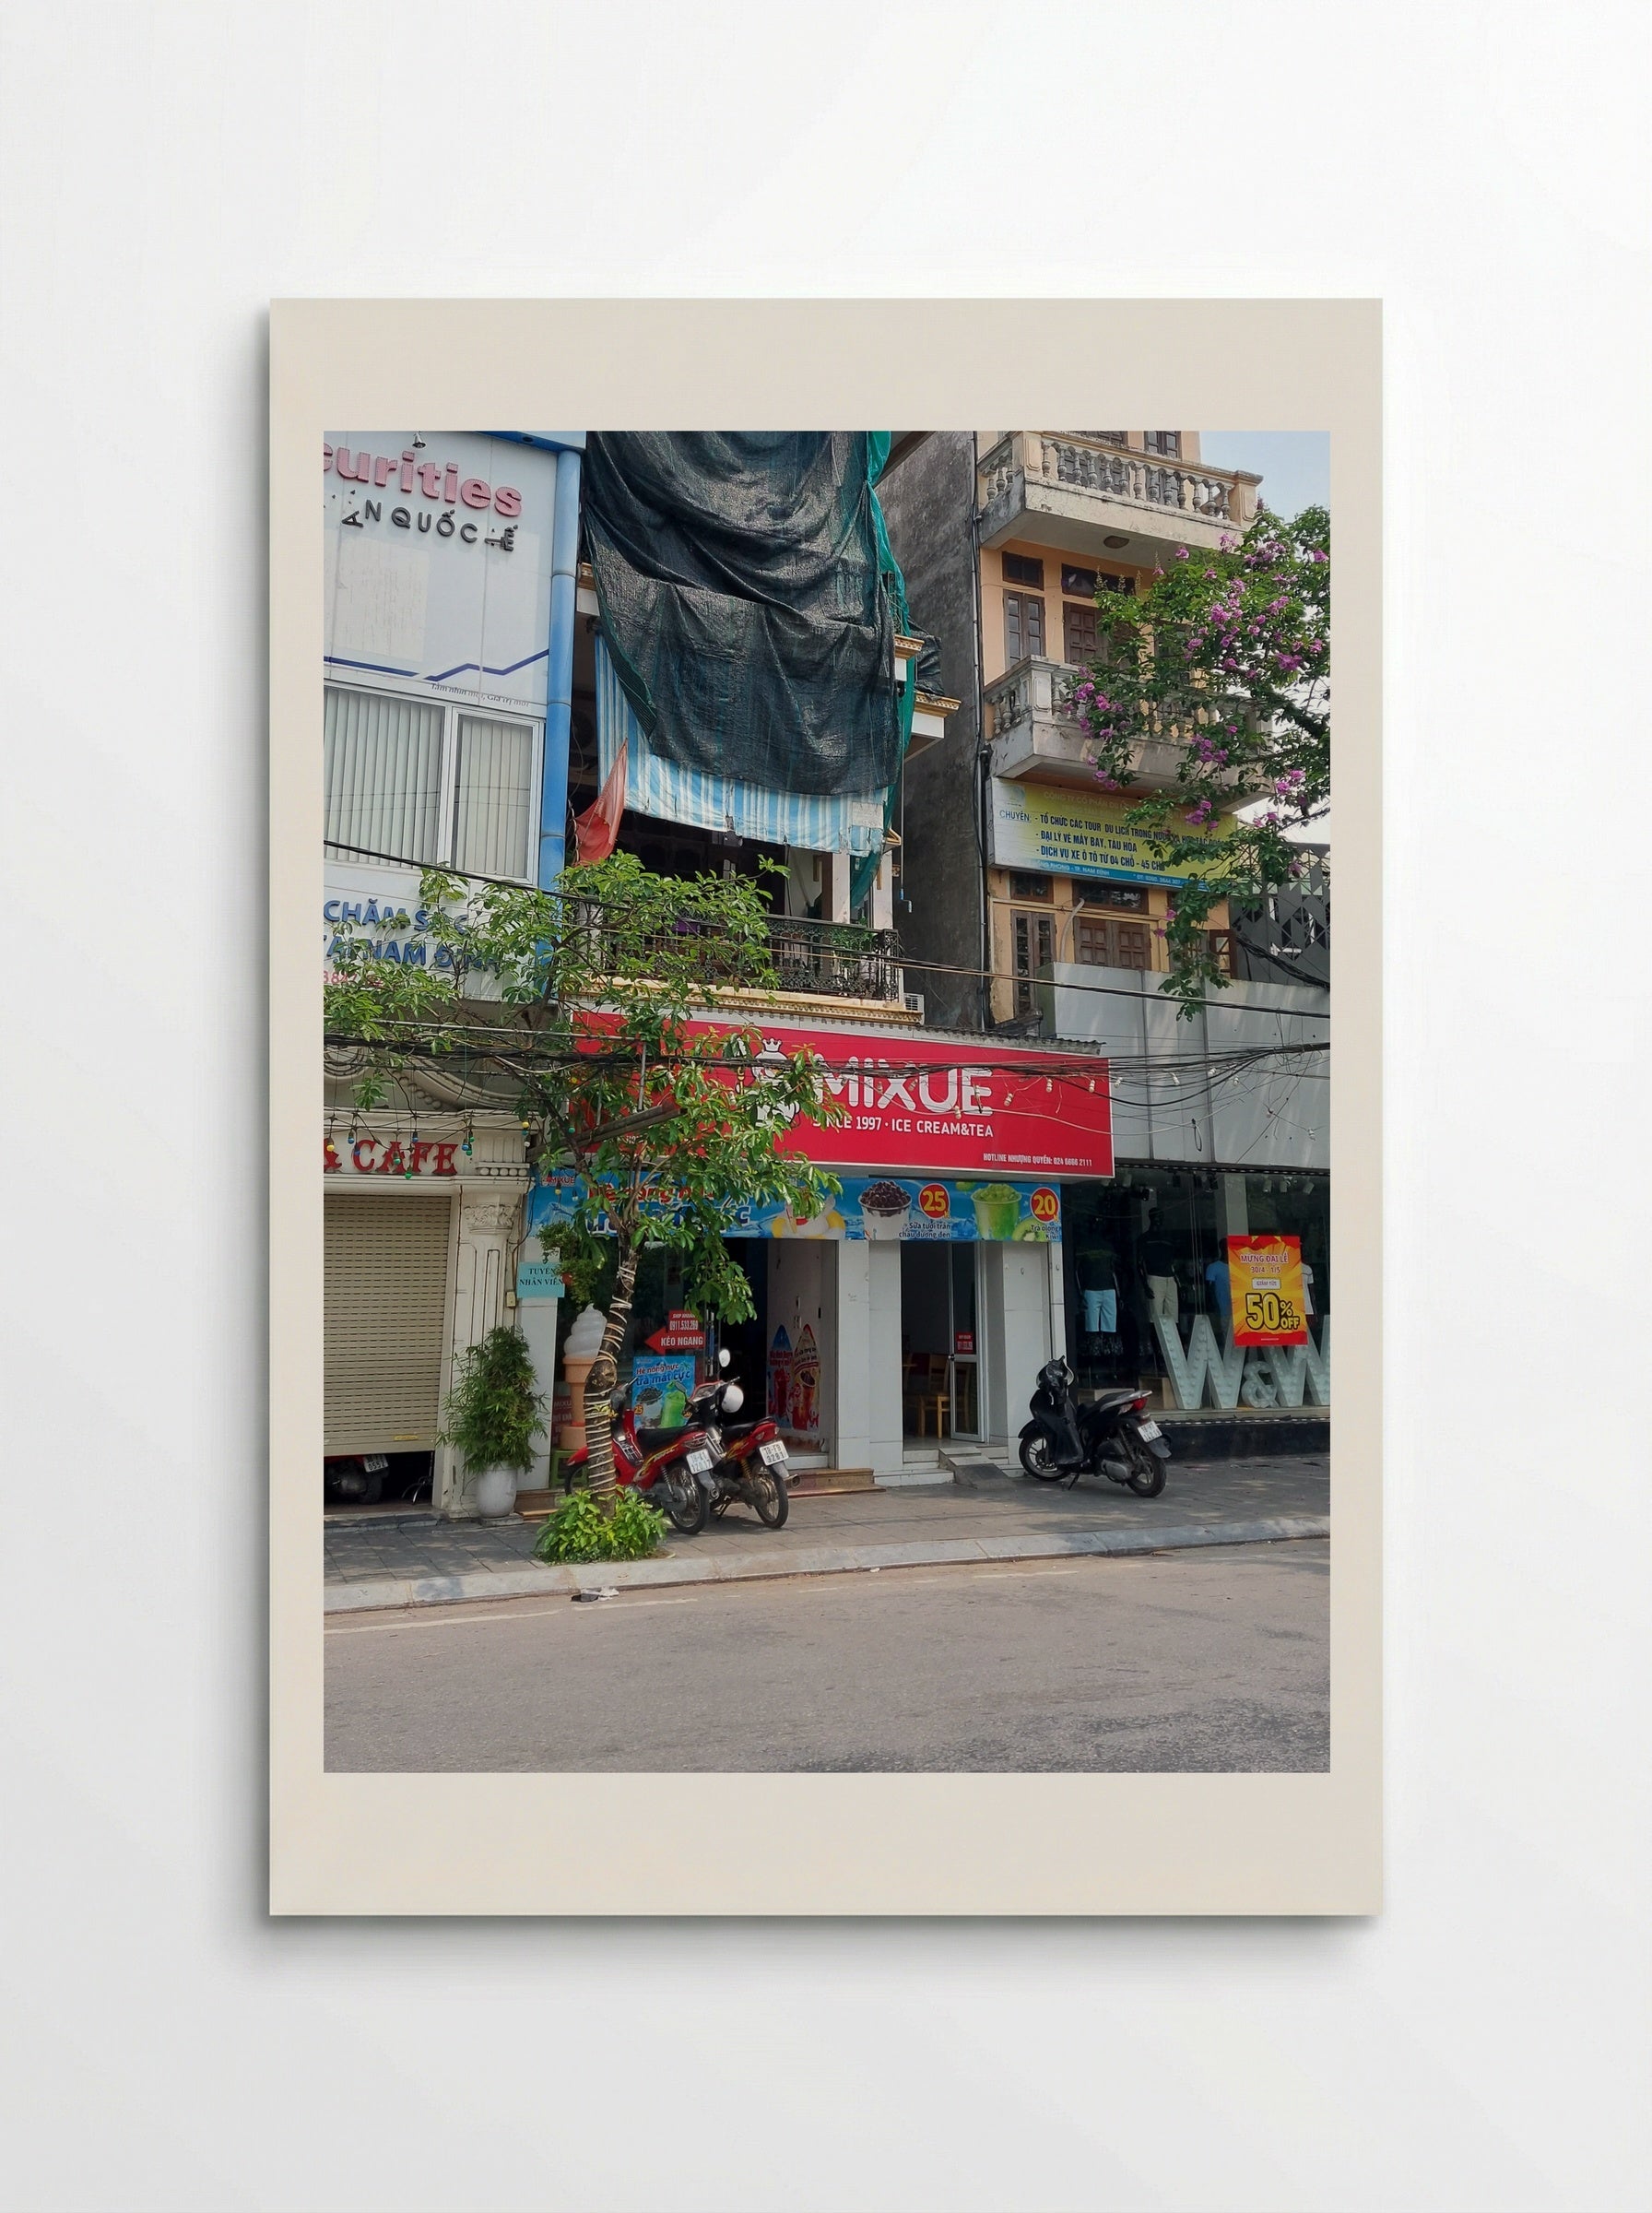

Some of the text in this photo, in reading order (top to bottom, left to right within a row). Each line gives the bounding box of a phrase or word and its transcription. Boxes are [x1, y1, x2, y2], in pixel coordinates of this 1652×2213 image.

[1040, 811, 1048, 823] TỔ
[1051, 815, 1068, 826] CHỨC
[1069, 817, 1082, 829] CÁC
[1084, 821, 1101, 832] TOUR
[1105, 823, 1114, 833] DU
[1115, 825, 1129, 836] LỊCH
[1131, 828, 1152, 839] TRONG
[1041, 830, 1052, 842] ĐẠI
[1054, 832, 1061, 841] LÝ
[1073, 834, 1088, 846] MÁY
[1041, 846, 1057, 858] DỊCH
[1060, 848, 1068, 860] VỤ
[1071, 850, 1080, 859] XE
[1110, 857, 1119, 865] 04
[1141, 860, 1150, 869] 45
[813, 1053, 993, 1117] MIXUE
[856, 1116, 881, 1130] 1997
[891, 1118, 911, 1132] ICE
[916, 1120, 994, 1138] CREAM&TEA
[352, 1139, 458, 1176] CAFE
[984, 1153, 1007, 1162] HOTLINE
[1280, 1317, 1300, 1330] OFF
[661, 1335, 703, 1346] KÉO NGANG
